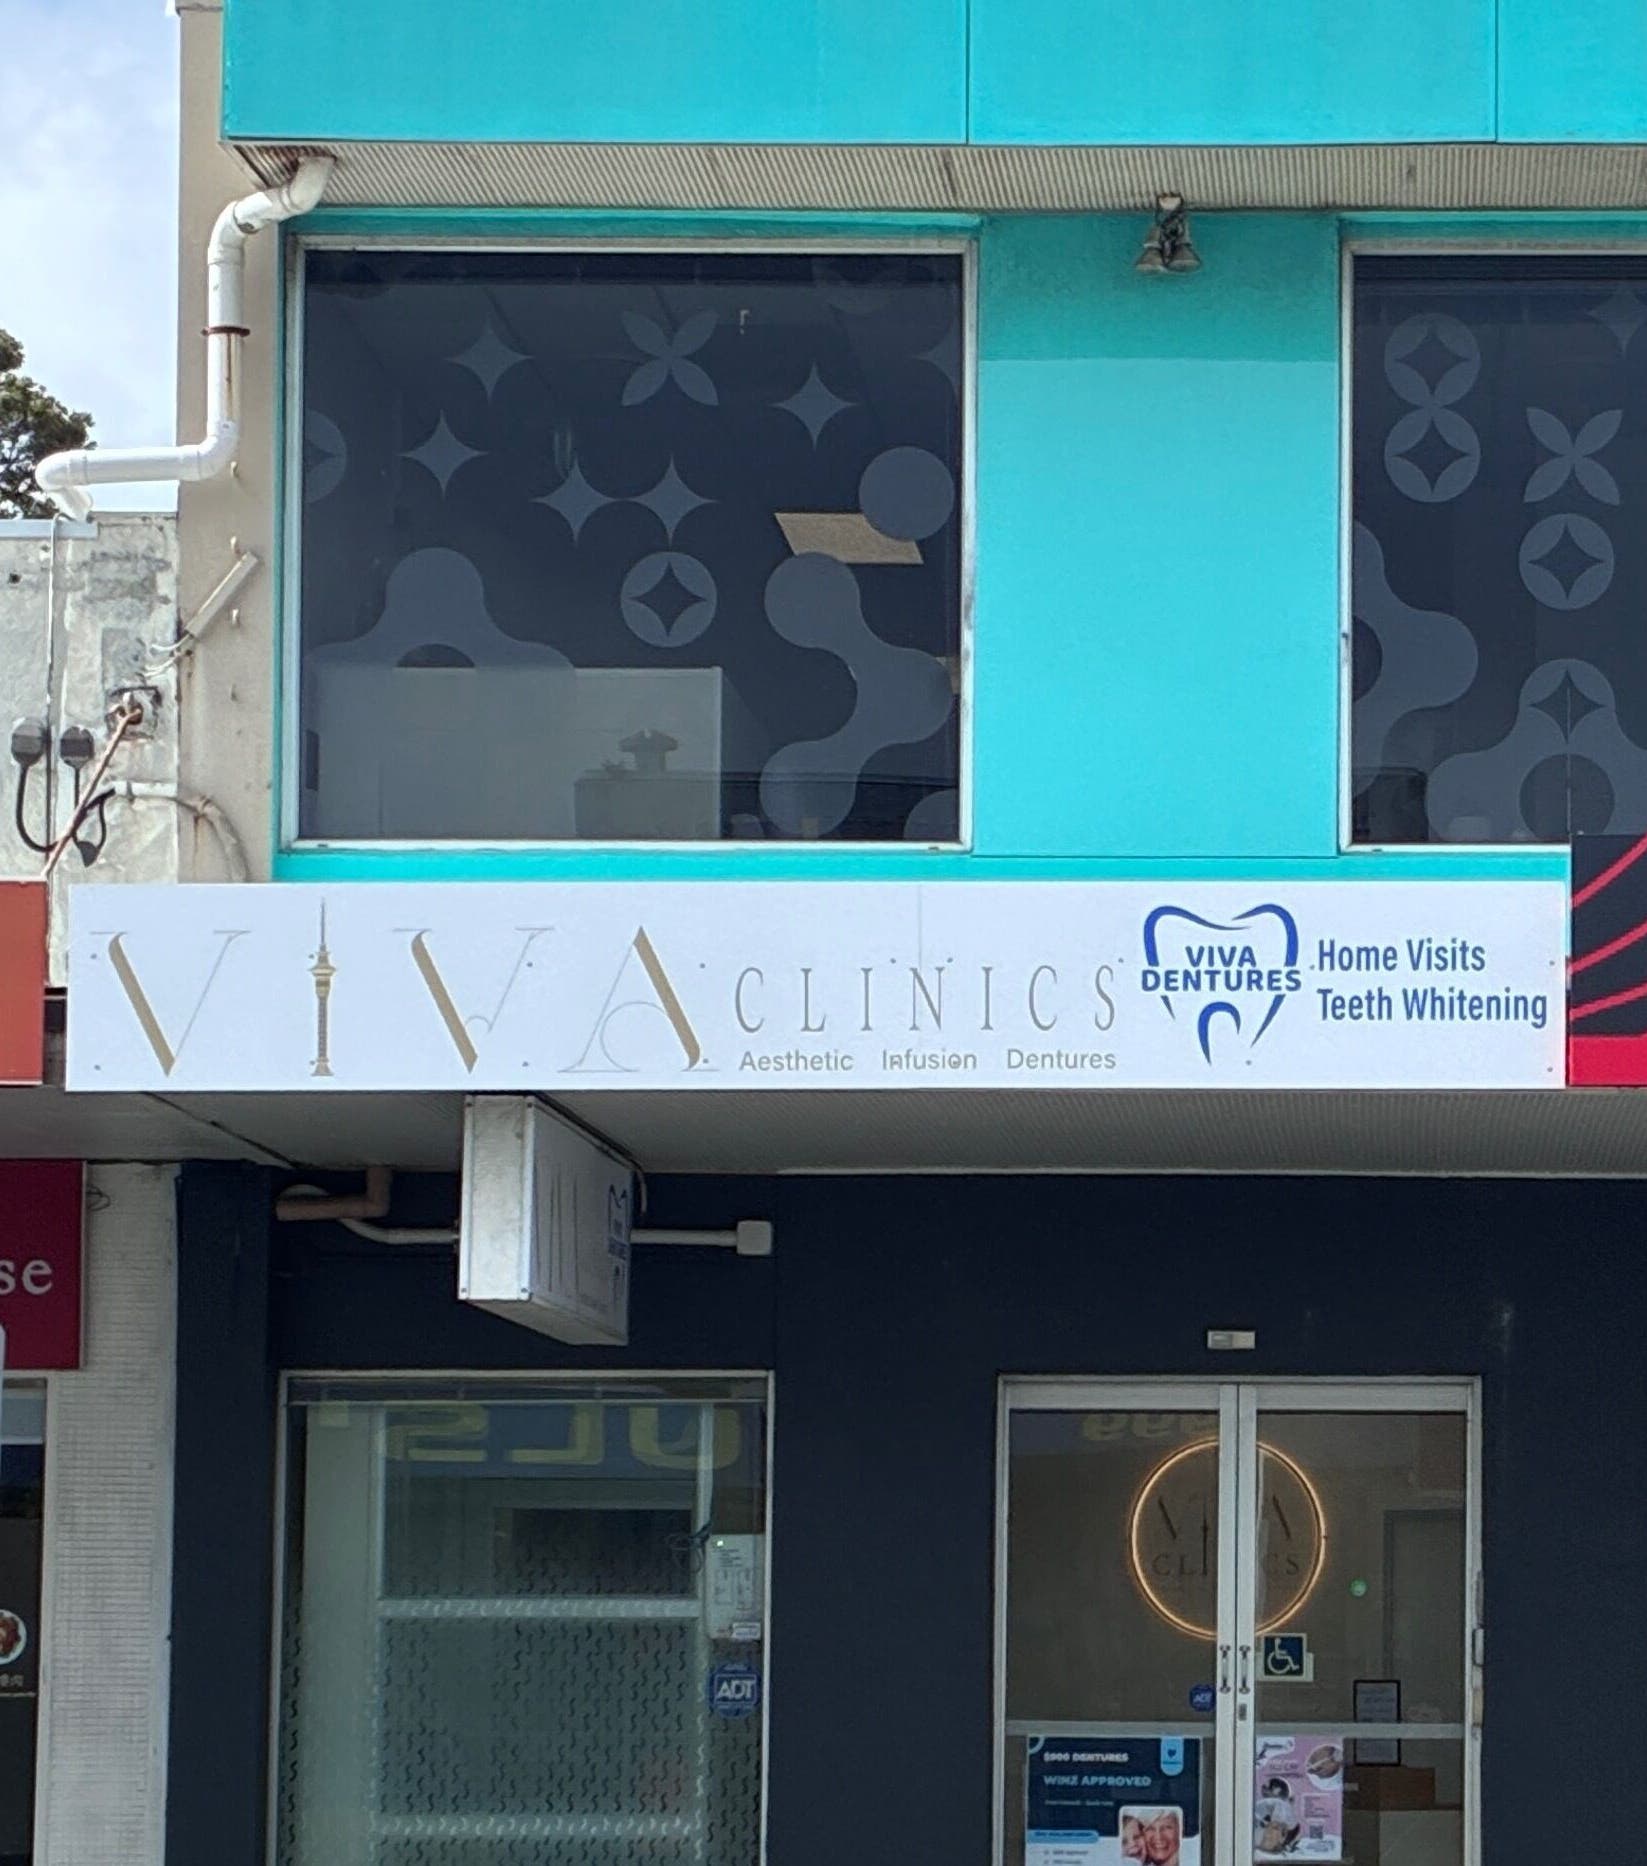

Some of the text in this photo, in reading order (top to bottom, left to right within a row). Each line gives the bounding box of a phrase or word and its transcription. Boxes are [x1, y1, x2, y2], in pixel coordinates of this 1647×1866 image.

[1185, 945, 1257, 968] VIVA
[1317, 936, 1486, 972] Home Visits
[90, 897, 1116, 1077] VIVA CLINICS
[1141, 969, 1302, 992] DENTURES
[1317, 986, 1548, 1029] Teeth Whitening
[738, 1047, 1117, 1072] Aesthetic Infusion Dentures
[717, 1679, 755, 1699] ADT
[1081, 1775, 1152, 1788] APPROVED
